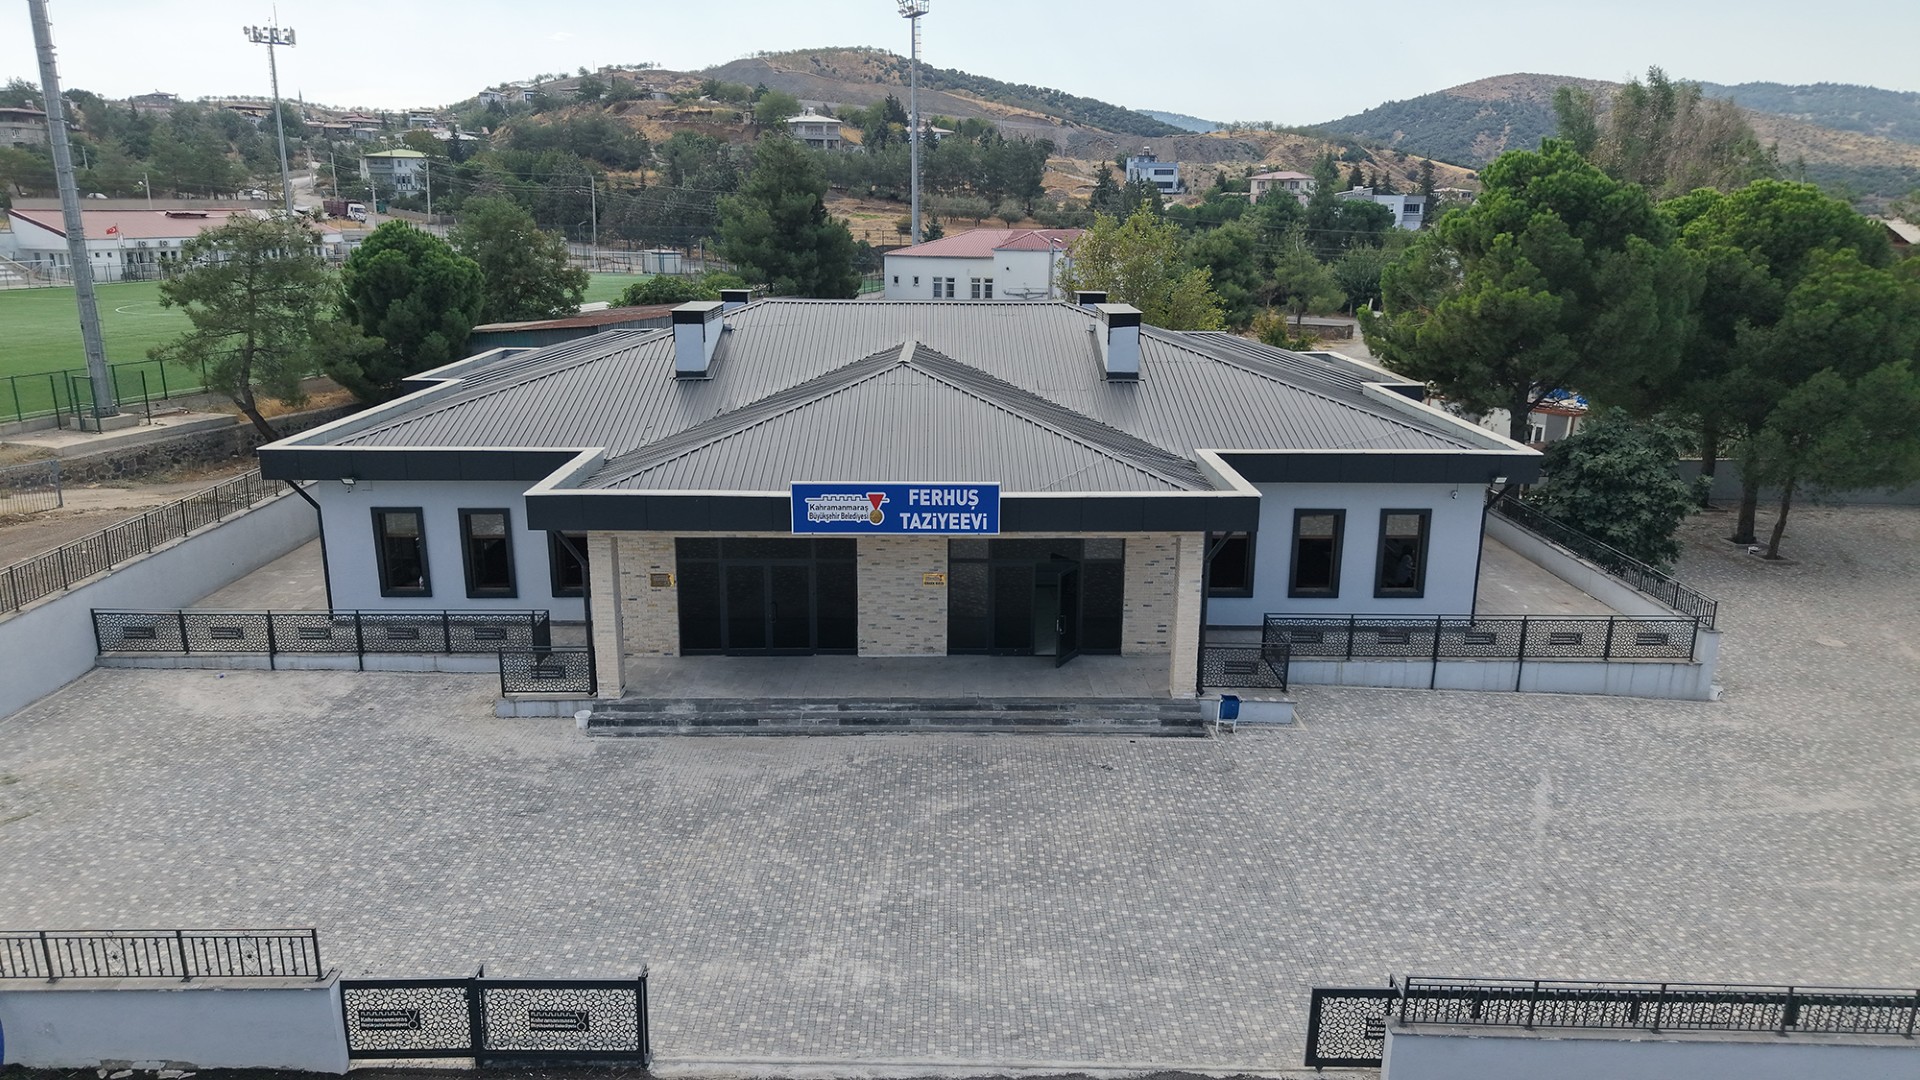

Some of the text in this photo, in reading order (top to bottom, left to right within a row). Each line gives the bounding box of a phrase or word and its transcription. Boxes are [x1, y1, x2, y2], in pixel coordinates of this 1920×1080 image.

[908, 489, 979, 511] FERHUŞ
[809, 503, 869, 512] Kahramanmaraş
[809, 512, 869, 521] Büyükşehir Belediyesi
